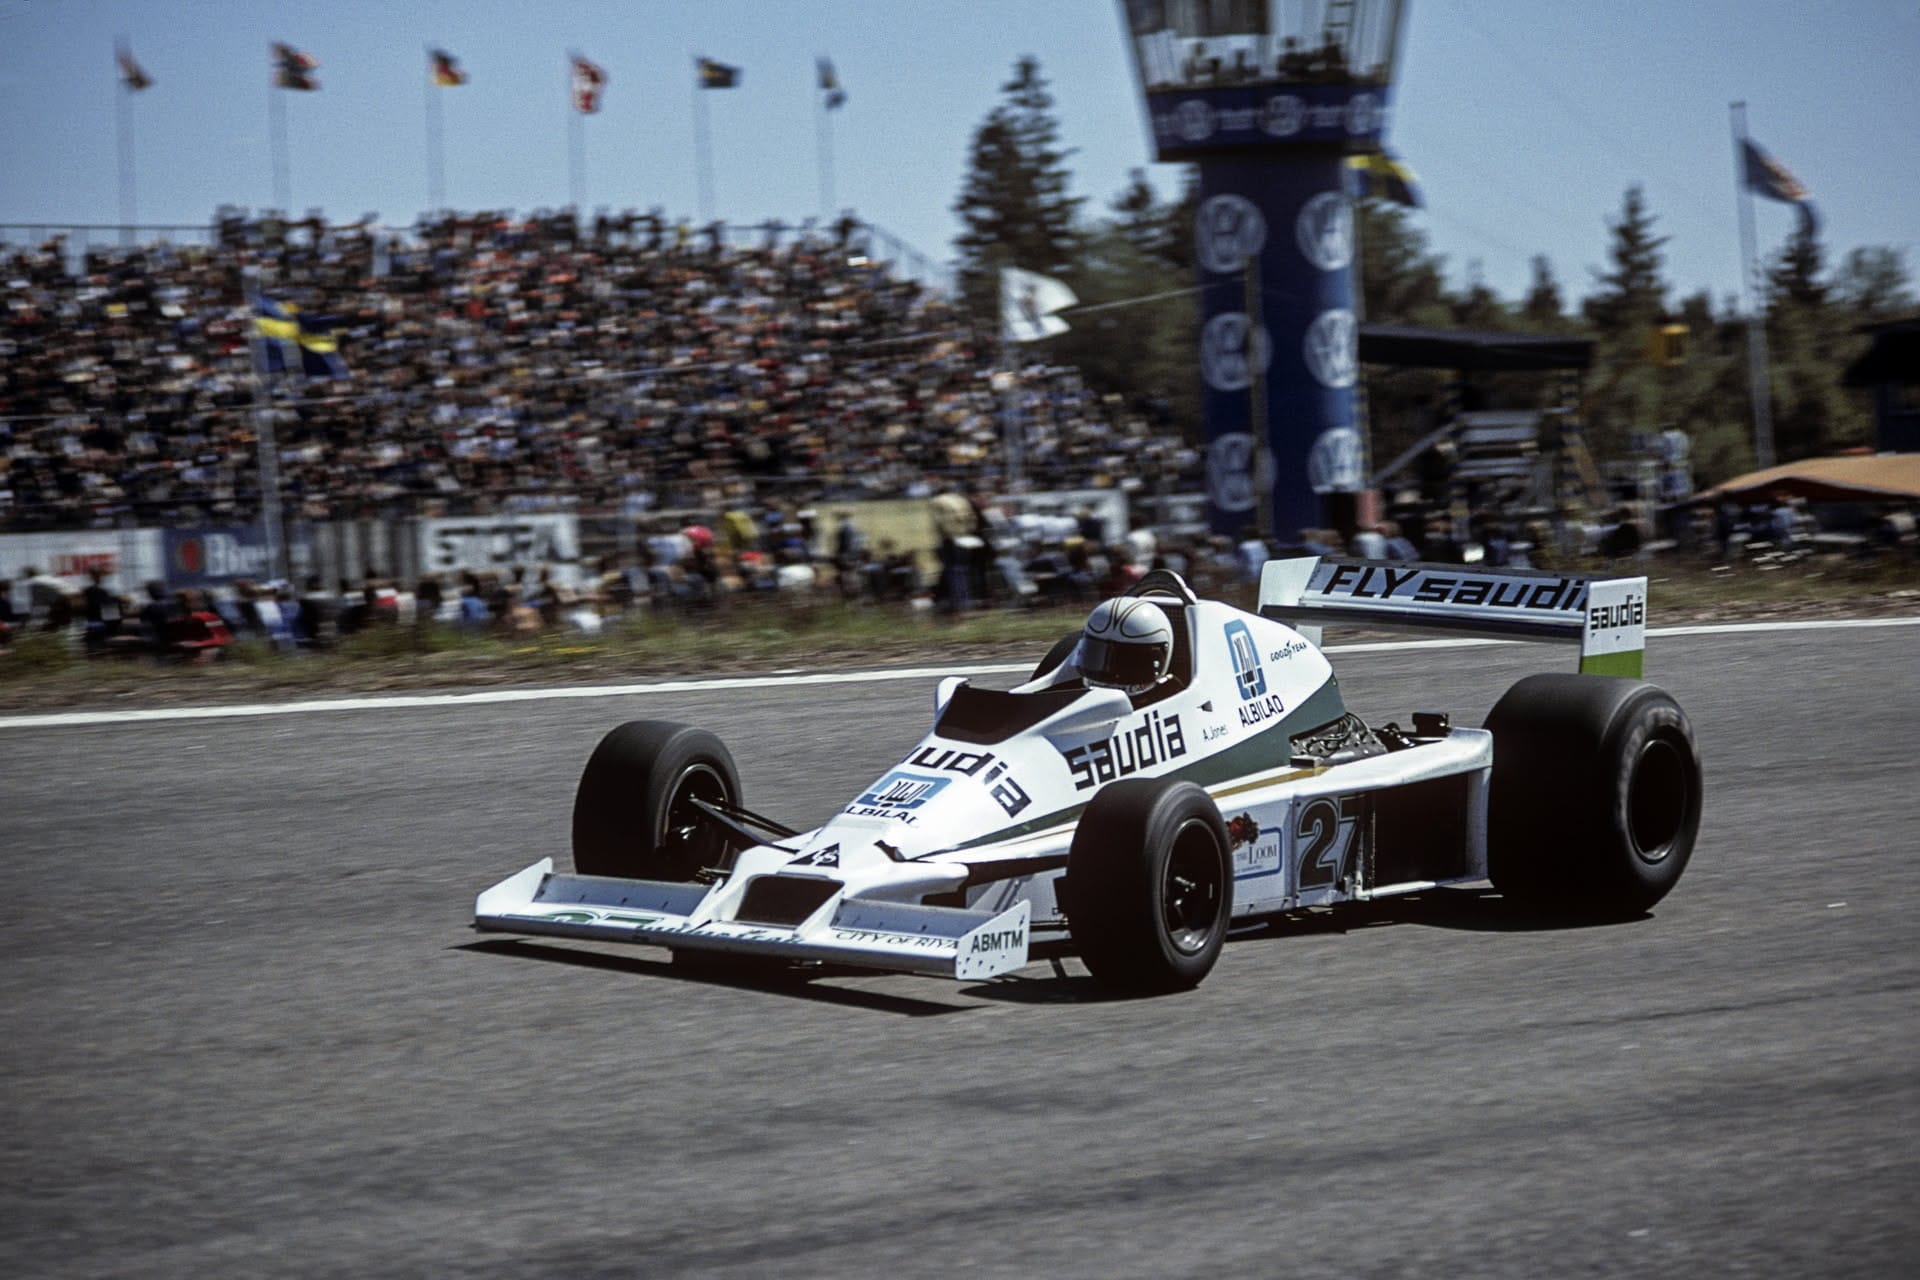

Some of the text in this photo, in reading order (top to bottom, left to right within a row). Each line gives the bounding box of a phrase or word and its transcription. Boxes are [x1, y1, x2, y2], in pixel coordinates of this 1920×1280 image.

[1321, 564, 1419, 600] FLY
[1591, 594, 1643, 630] saudia
[1238, 694, 1285, 728] ALBILAD
[1061, 709, 1187, 791] saudia
[1298, 793, 1366, 892] 27
[836, 930, 886, 943] CITY
[970, 929, 1024, 954] ABMTM
